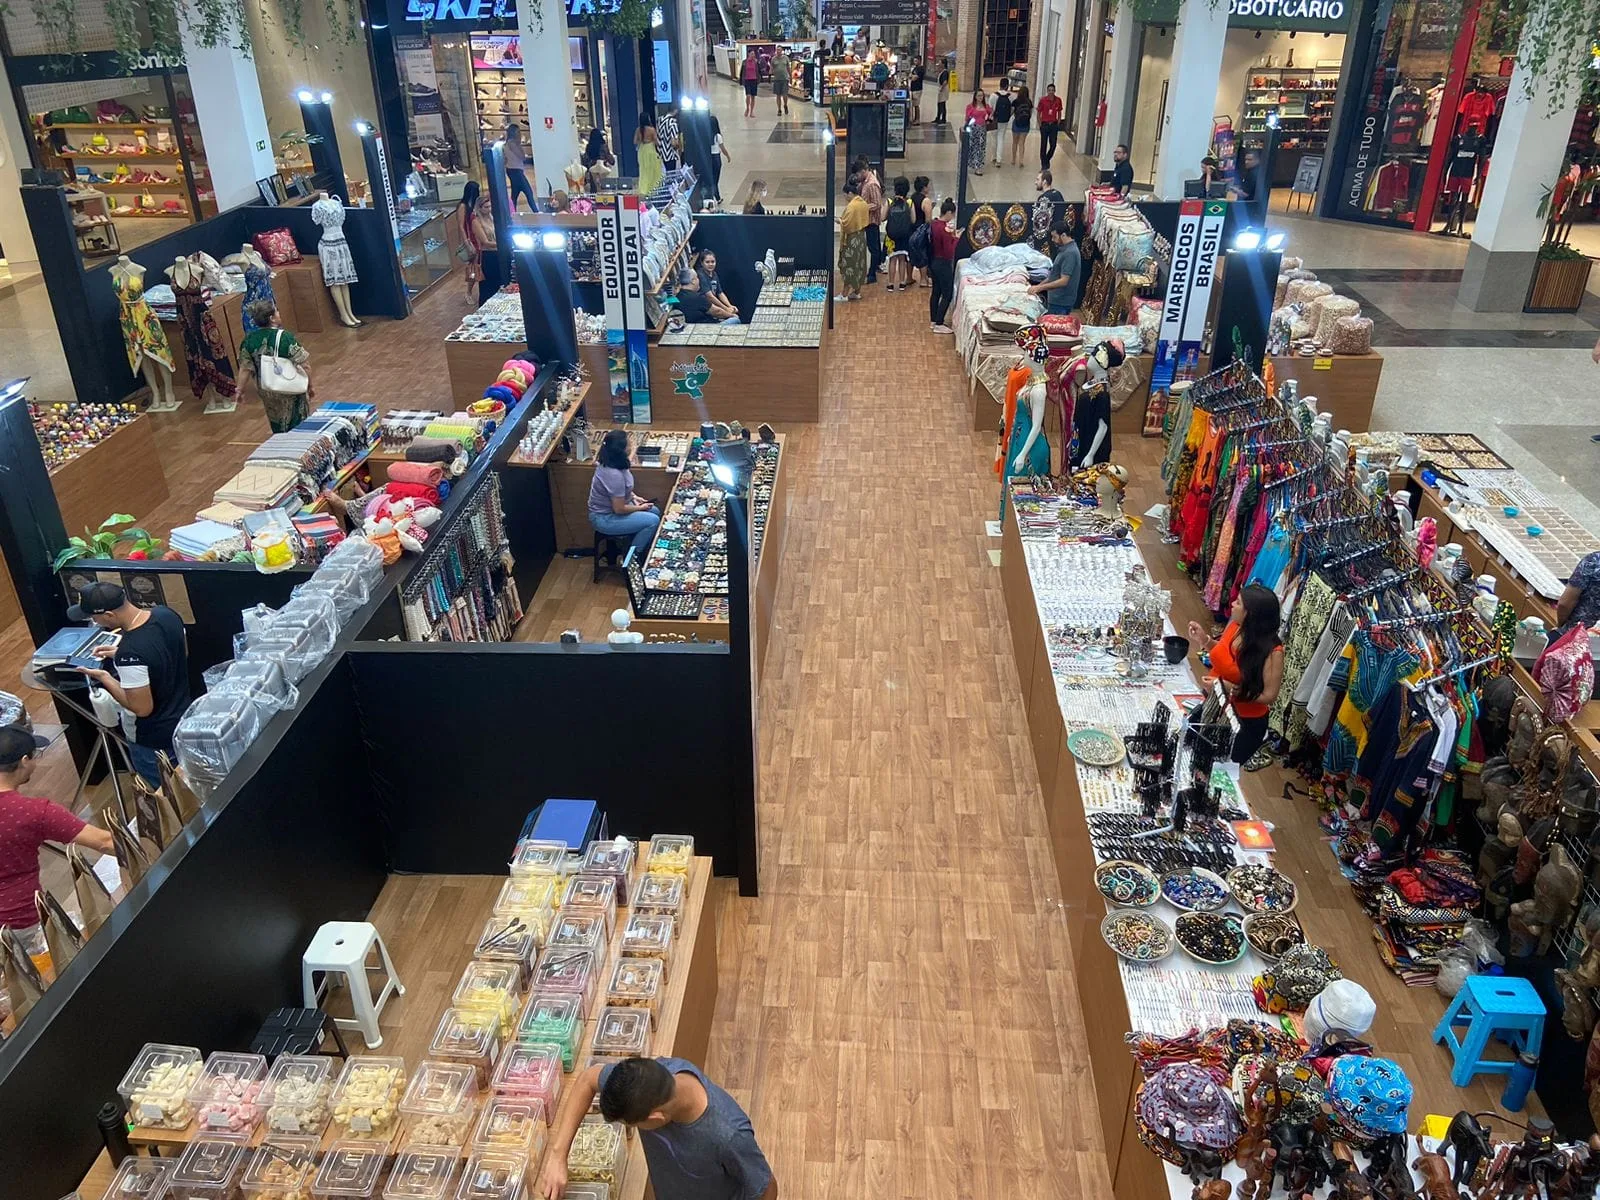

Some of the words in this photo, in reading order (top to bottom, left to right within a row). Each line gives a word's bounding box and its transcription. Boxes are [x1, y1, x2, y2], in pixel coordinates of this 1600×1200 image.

[1357, 154, 1368, 168] DE
[1360, 117, 1376, 151] TUDO
[1349, 171, 1364, 207] ACIMA
[602, 217, 619, 299] EQUADOR
[624, 226, 640, 299] DUBAI
[1166, 222, 1195, 323] MARROCOS
[1195, 223, 1220, 287] BRASIL
